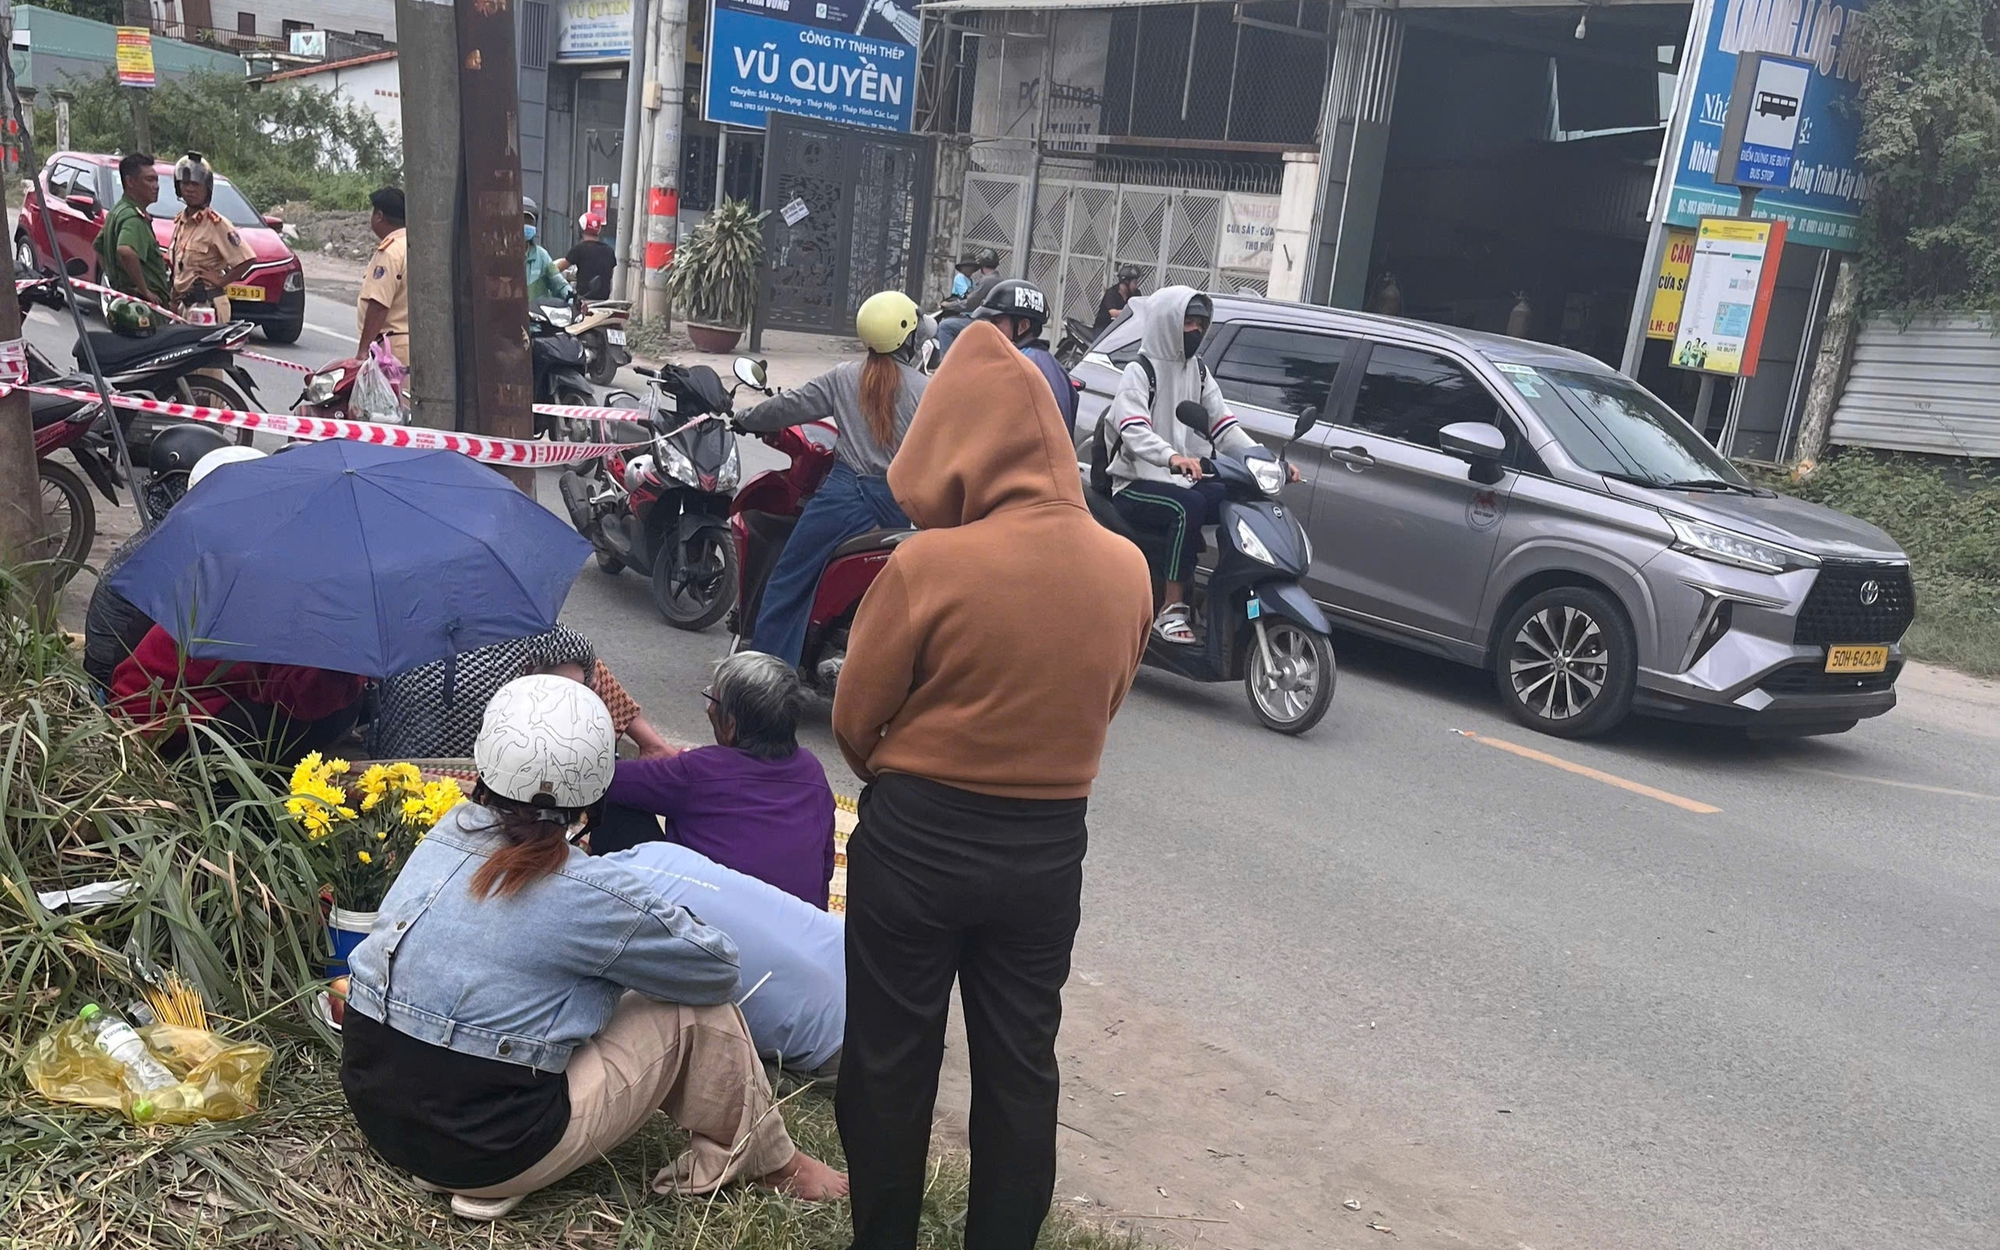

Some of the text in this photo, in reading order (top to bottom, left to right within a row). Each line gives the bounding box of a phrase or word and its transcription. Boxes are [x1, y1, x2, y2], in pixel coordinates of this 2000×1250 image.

[799, 30, 905, 60] CÔNG TY TNHH THÉP
[734, 42, 903, 105] VŨ QUYỀN
[730, 86, 757, 97] Chuyên:
[771, 92, 783, 104] Xây
[807, 99, 822, 110] Thép
[842, 104, 858, 115] Thép
[1688, 140, 1719, 174] Nhôm
[1740, 146, 1753, 161] ĐIỂM
[1769, 154, 1777, 166] XE
[1776, 154, 1790, 168] BUÝT
[1749, 167, 1775, 181] BUS STOP
[1790, 160, 1814, 194] Công
[1814, 164, 1838, 195] Trình
[1836, 168, 1857, 201] Xây
[1658, 272, 1675, 290] CỬA
[1649, 319, 1666, 332] LH:
[1832, 650, 1882, 667] 50H-642.04
